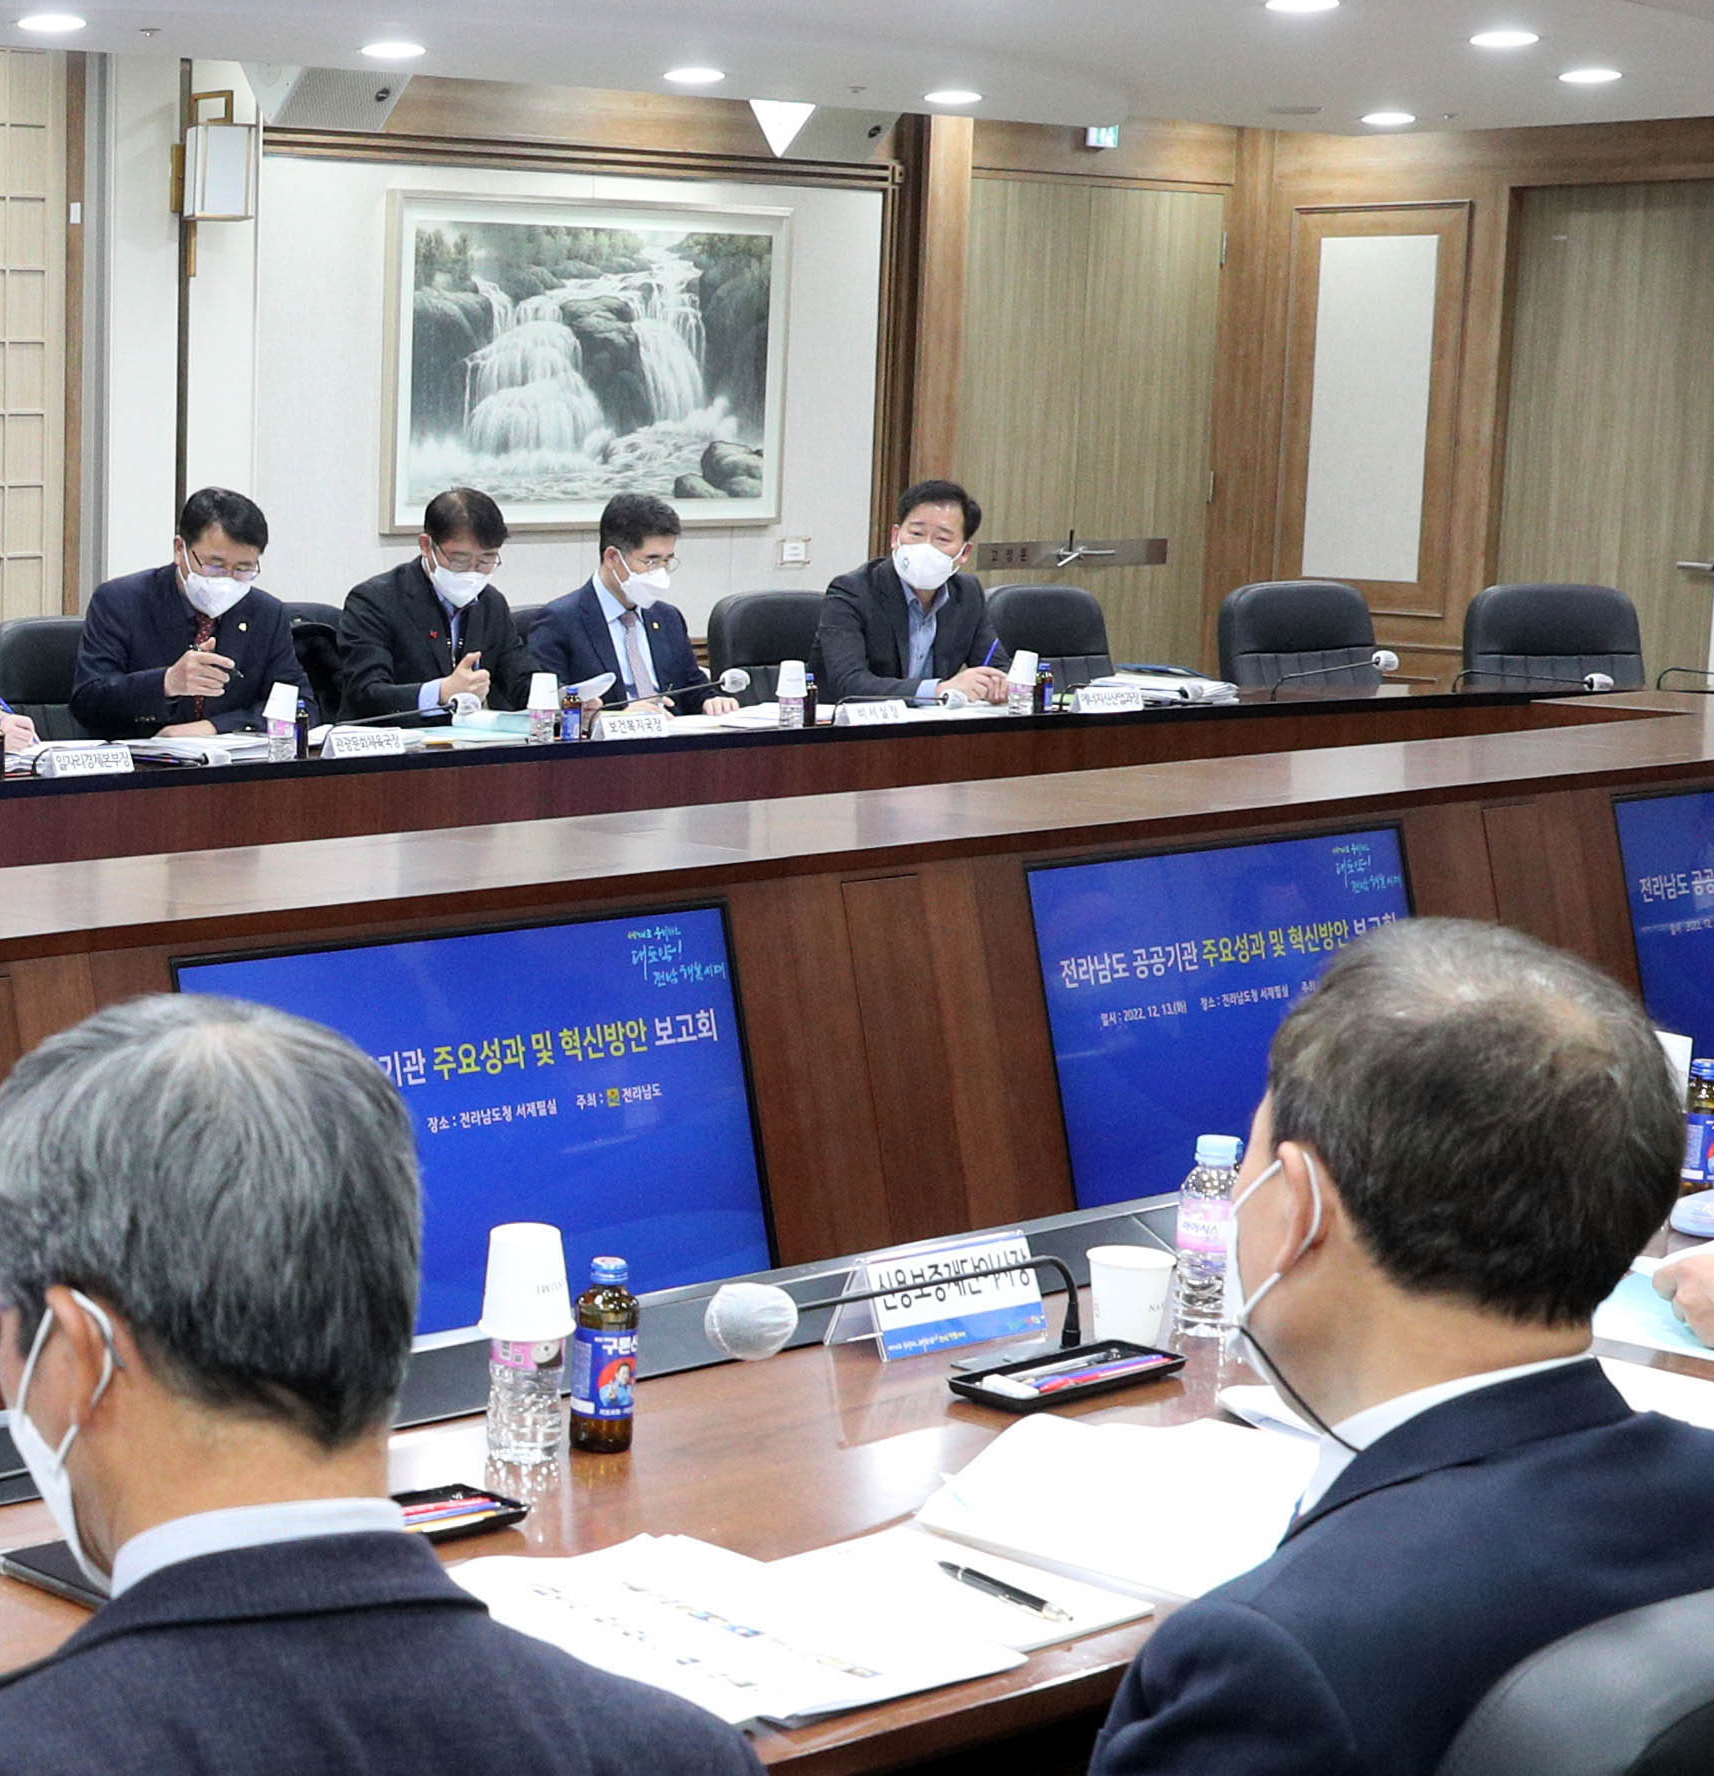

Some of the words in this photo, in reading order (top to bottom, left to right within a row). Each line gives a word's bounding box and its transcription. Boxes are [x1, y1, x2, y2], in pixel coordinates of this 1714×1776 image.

[608, 717, 663, 734] 보건복지국장
[55, 751, 130, 771] 일자리경제본부장
[1639, 872, 1690, 903] 전라남도
[1059, 952, 1130, 990] 전라남도
[1132, 940, 1200, 980] 공공기관
[1201, 932, 1267, 968] 주요성과
[1268, 926, 1287, 958] 및
[1287, 919, 1349, 954] 혁신방안
[1221, 989, 1259, 1008] 전라남도청
[433, 1038, 527, 1081] 주요성과
[530, 1029, 555, 1066] 및
[557, 1017, 649, 1062] 혁신방안
[653, 1007, 719, 1047] 보고회
[427, 1114, 450, 1134] 장소
[459, 1104, 513, 1130] 전라남도청
[515, 1097, 558, 1120] 서재필실
[575, 1092, 598, 1111] 주최
[621, 1082, 663, 1103] 전라남도
